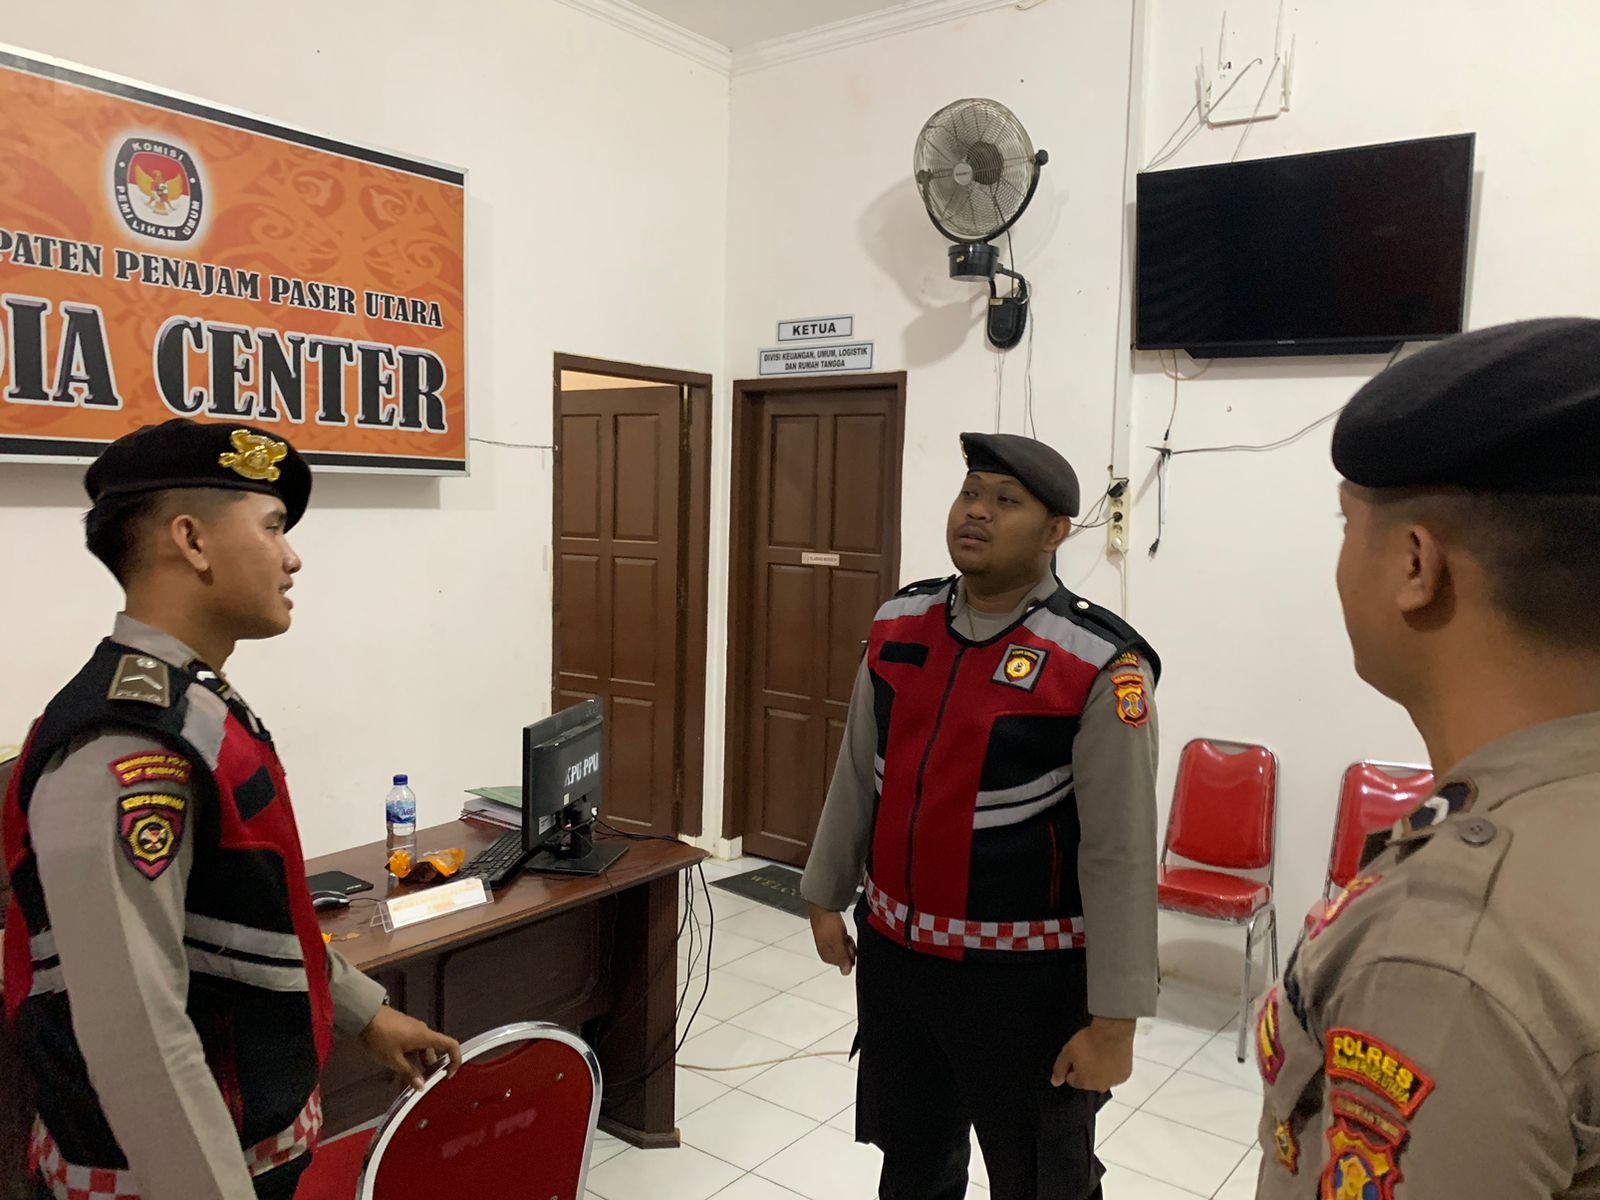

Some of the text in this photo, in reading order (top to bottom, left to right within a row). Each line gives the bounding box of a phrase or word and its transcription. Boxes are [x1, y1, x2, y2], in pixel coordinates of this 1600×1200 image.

[131, 142, 184, 160] KOMISI
[116, 185, 201, 238] PEMILIHAN UMUM
[115, 249, 260, 300] PENAJAM
[270, 276, 356, 315] PASER
[364, 291, 443, 327] UTARA
[792, 322, 836, 337] KETUA
[0, 298, 446, 430] IA CENTER
[764, 347, 868, 362] DIVISI KEUANGAN, UMUM, LOGISTIK
[785, 359, 845, 371] DAN RUMAH TANGGA
[564, 752, 599, 787] KPU PPU
[1333, 1036, 1413, 1090] POLRES
